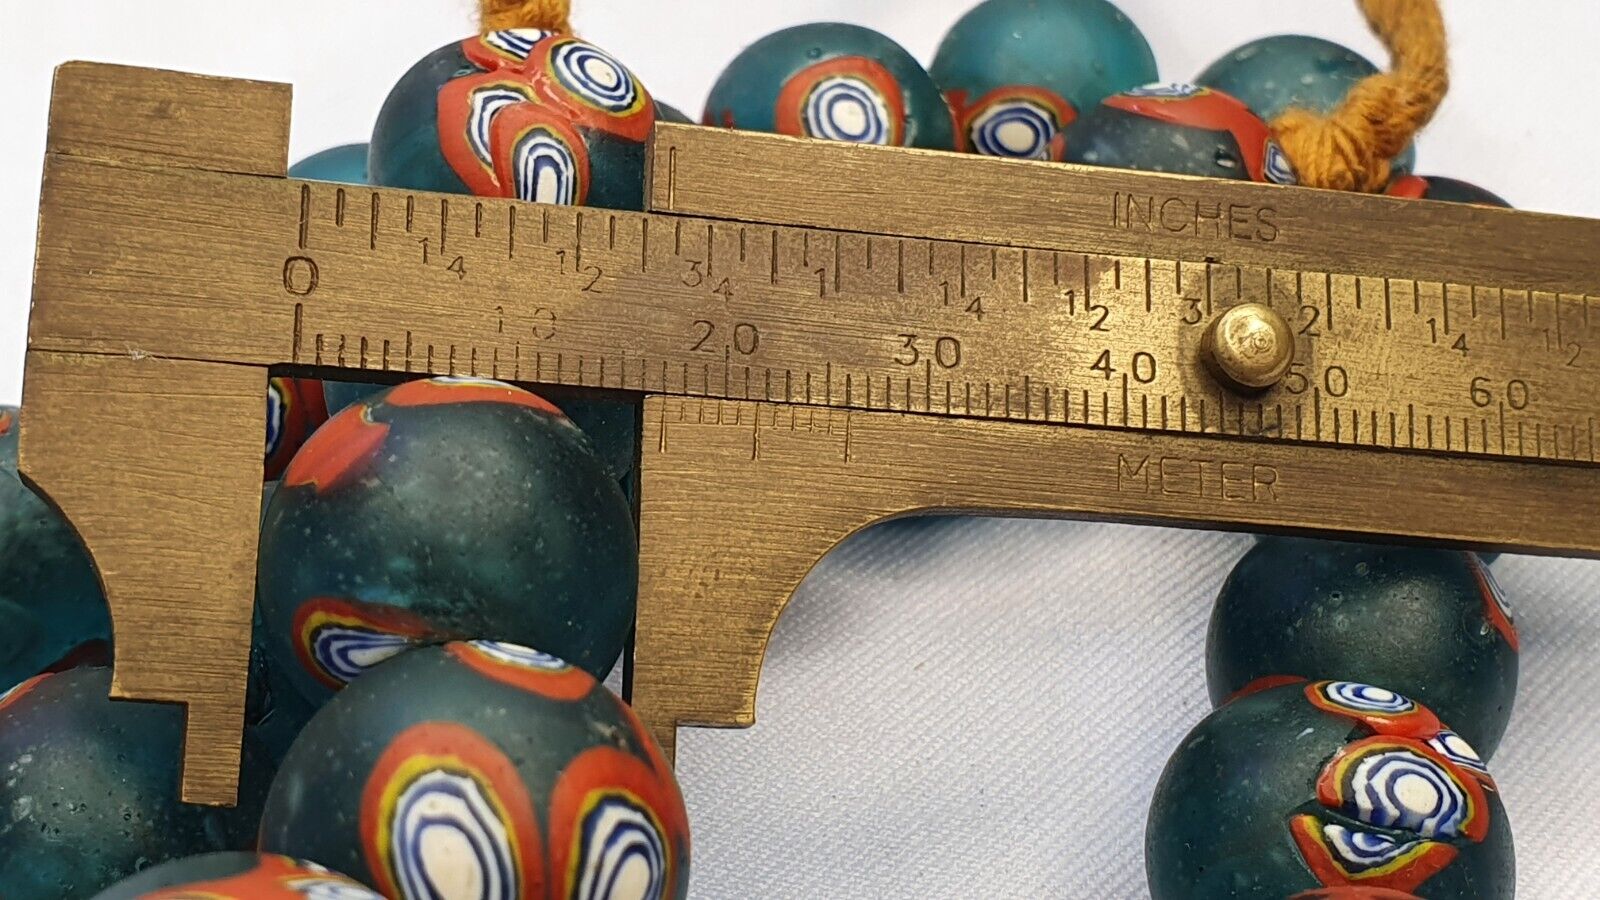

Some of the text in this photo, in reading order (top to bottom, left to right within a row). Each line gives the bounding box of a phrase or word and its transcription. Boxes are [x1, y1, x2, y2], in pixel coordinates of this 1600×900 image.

[1112, 192, 1280, 243] INCHES
[283, 256, 319, 295] 0
[690, 319, 760, 356] 20
[894, 333, 962, 369] 30
[1090, 349, 1157, 384] 40
[1470, 376, 1529, 411] 60
[1117, 453, 1279, 501] METER
